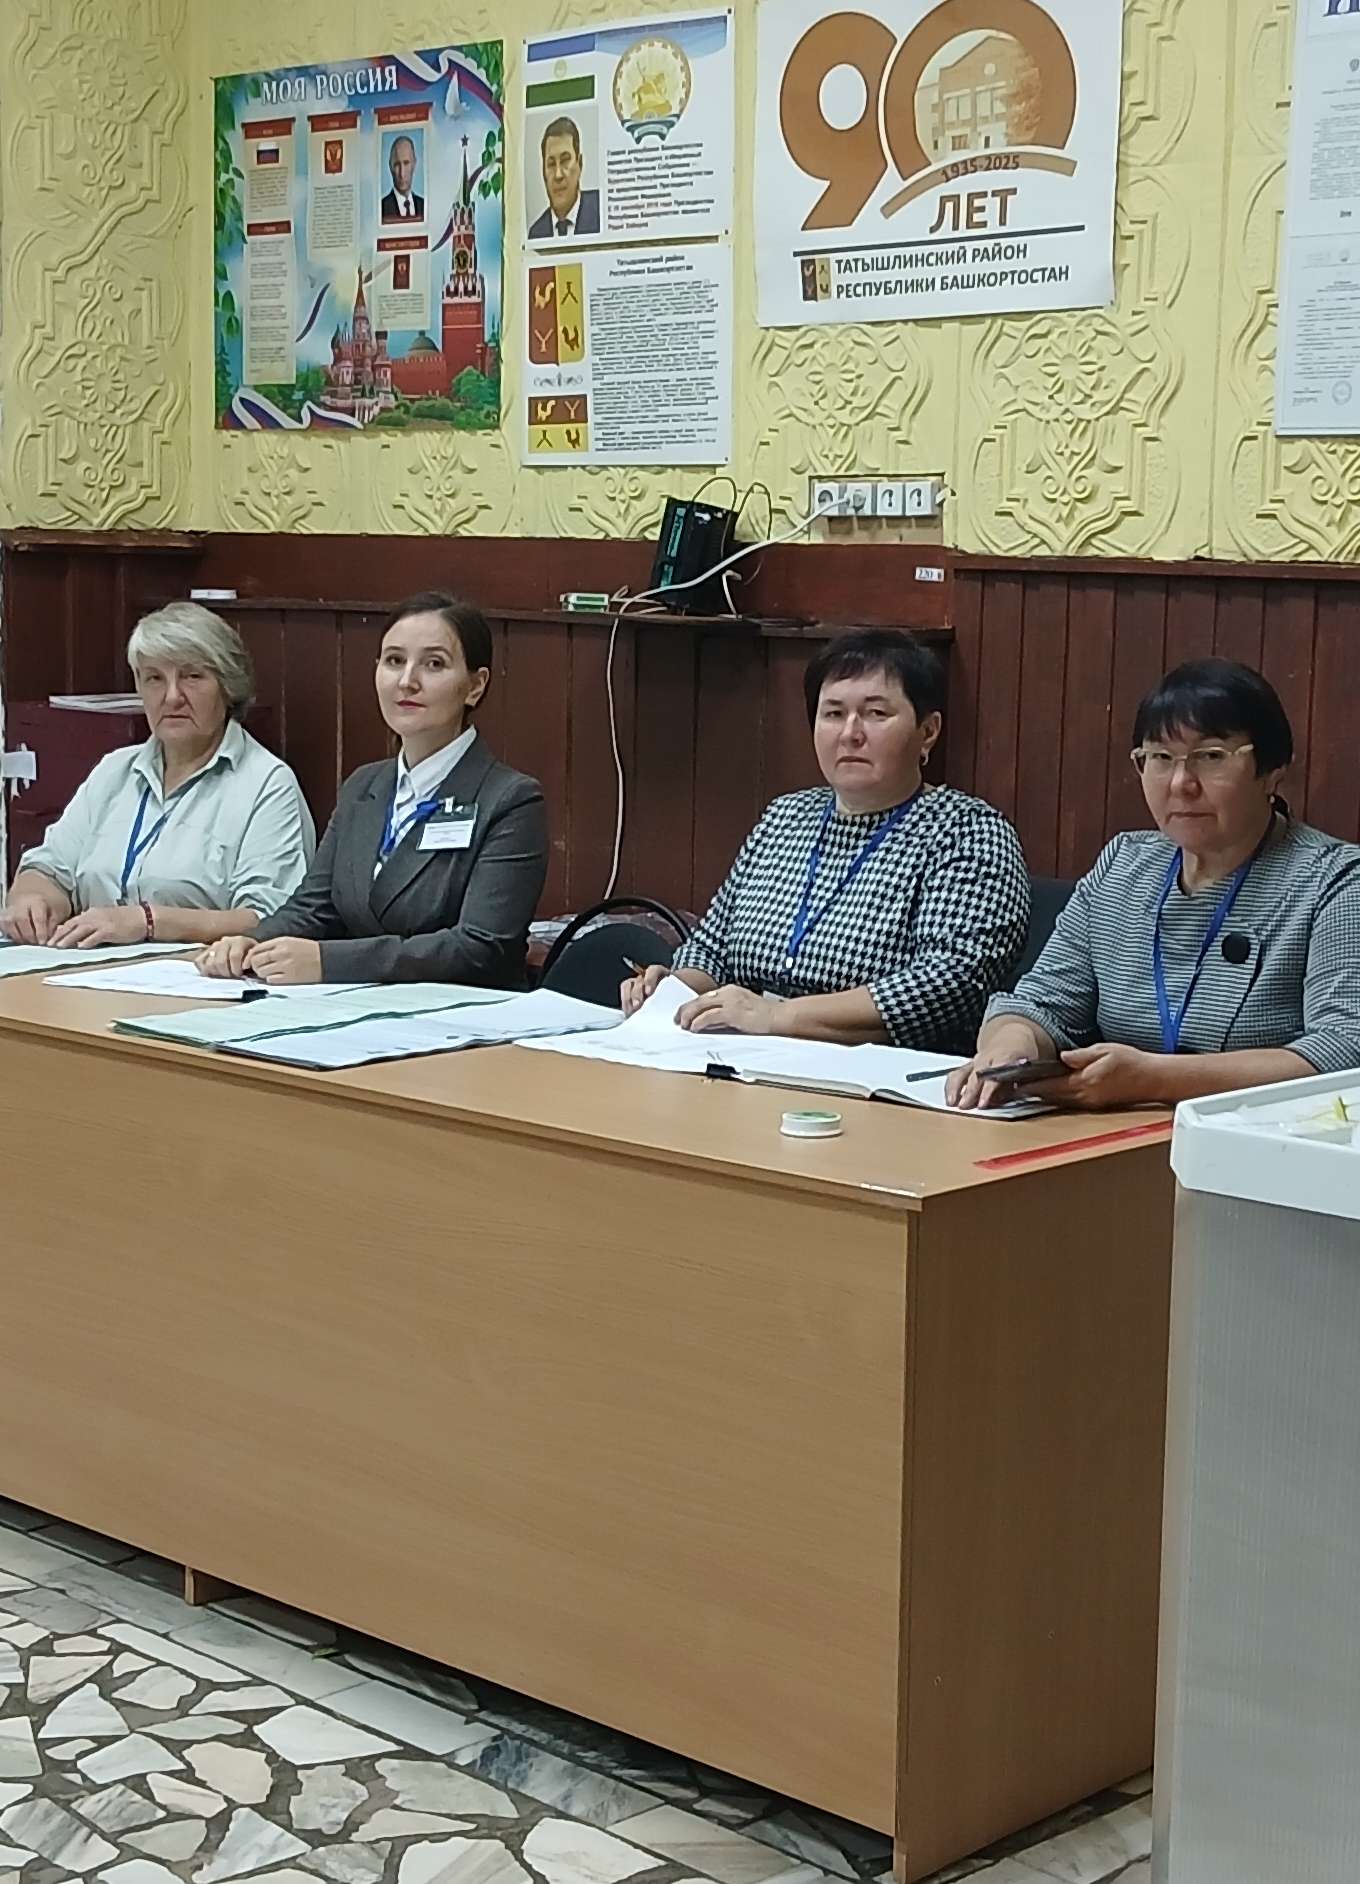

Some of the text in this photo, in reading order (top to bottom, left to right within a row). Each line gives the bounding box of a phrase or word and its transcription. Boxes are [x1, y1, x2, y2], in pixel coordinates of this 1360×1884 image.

[261, 65, 398, 105] МОЯ РОССИЯ
[779, 0, 1077, 231] 90
[941, 154, 1021, 183] 1935-2025
[928, 187, 1018, 235] ЛЕТ
[835, 243, 1028, 275] ТАТЫШЛИНСКИЙ РАЙОН
[837, 265, 1070, 299] РЕСПУБЛИКИ БАШКОРТОСТАН
